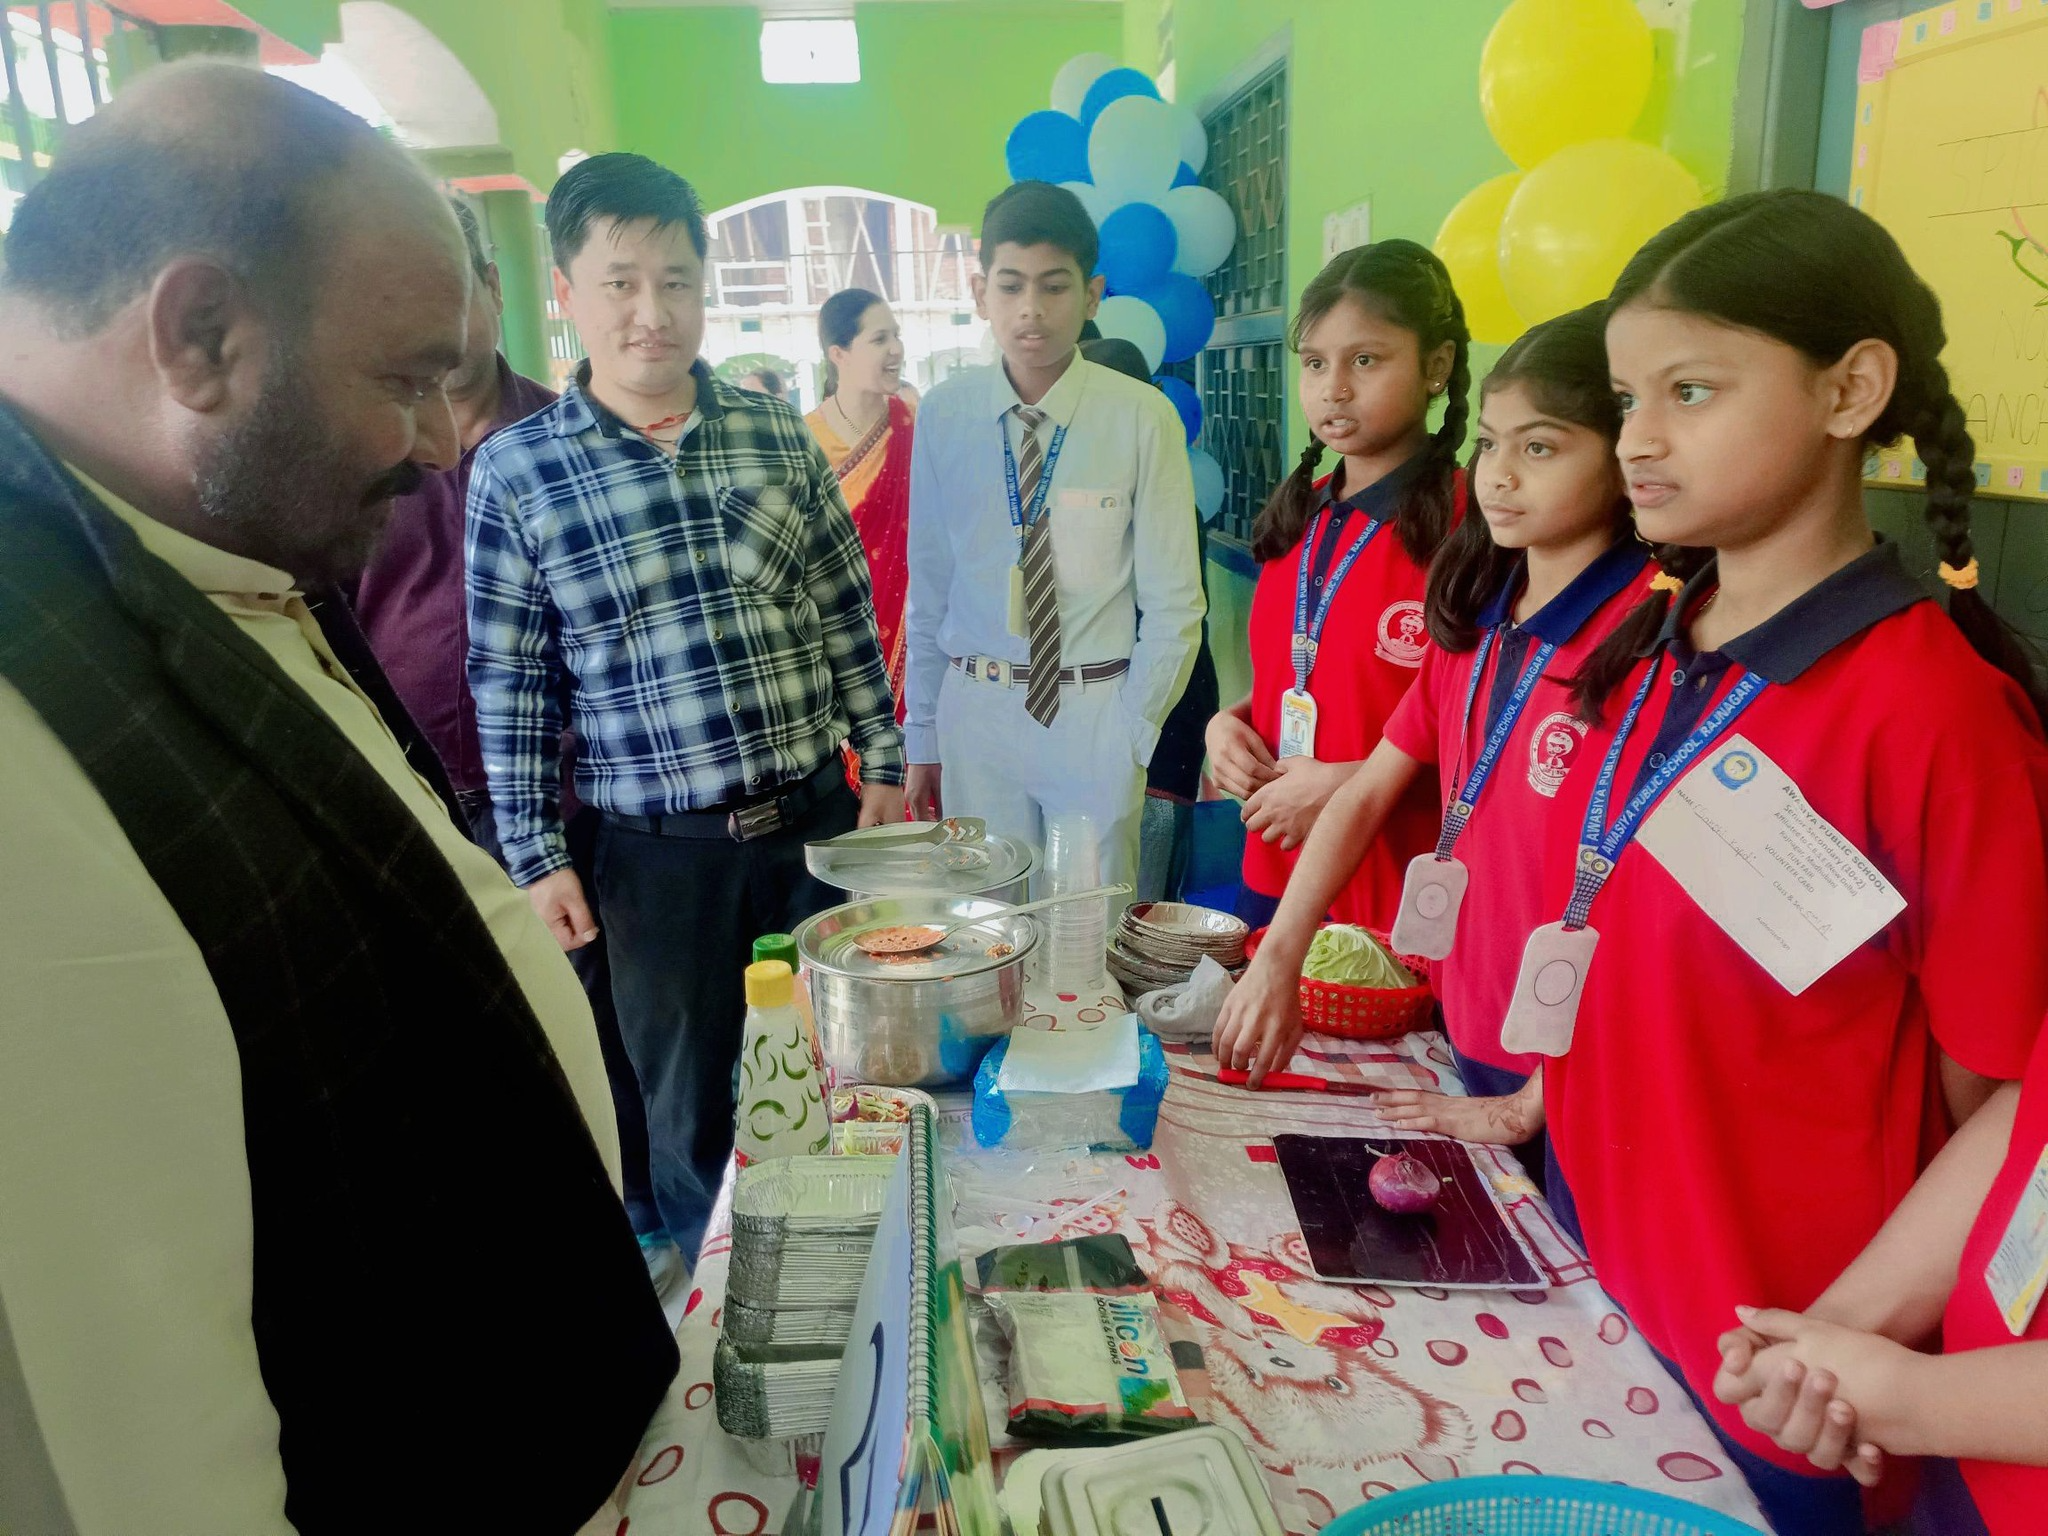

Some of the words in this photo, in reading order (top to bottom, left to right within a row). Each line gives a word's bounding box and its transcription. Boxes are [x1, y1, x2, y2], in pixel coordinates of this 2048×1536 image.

[1464, 762, 1487, 801] AWASIYA
[1482, 734, 1502, 768] PUBLIC
[1496, 700, 1520, 742] SCHOOL,
[1514, 655, 1545, 702] RAJNAGAR
[1601, 809, 1637, 857] AWASIYA
[1633, 774, 1664, 812] PUBLIC
[1662, 738, 1704, 780] SCHOOL,
[1702, 679, 1755, 737] RAJNAGAR
[1587, 789, 1607, 842] AWASIYA
[1599, 747, 1620, 787] PUBLIC
[1819, 825, 1852, 857] PUBLIC
[1851, 856, 1886, 894] SCHOOL
